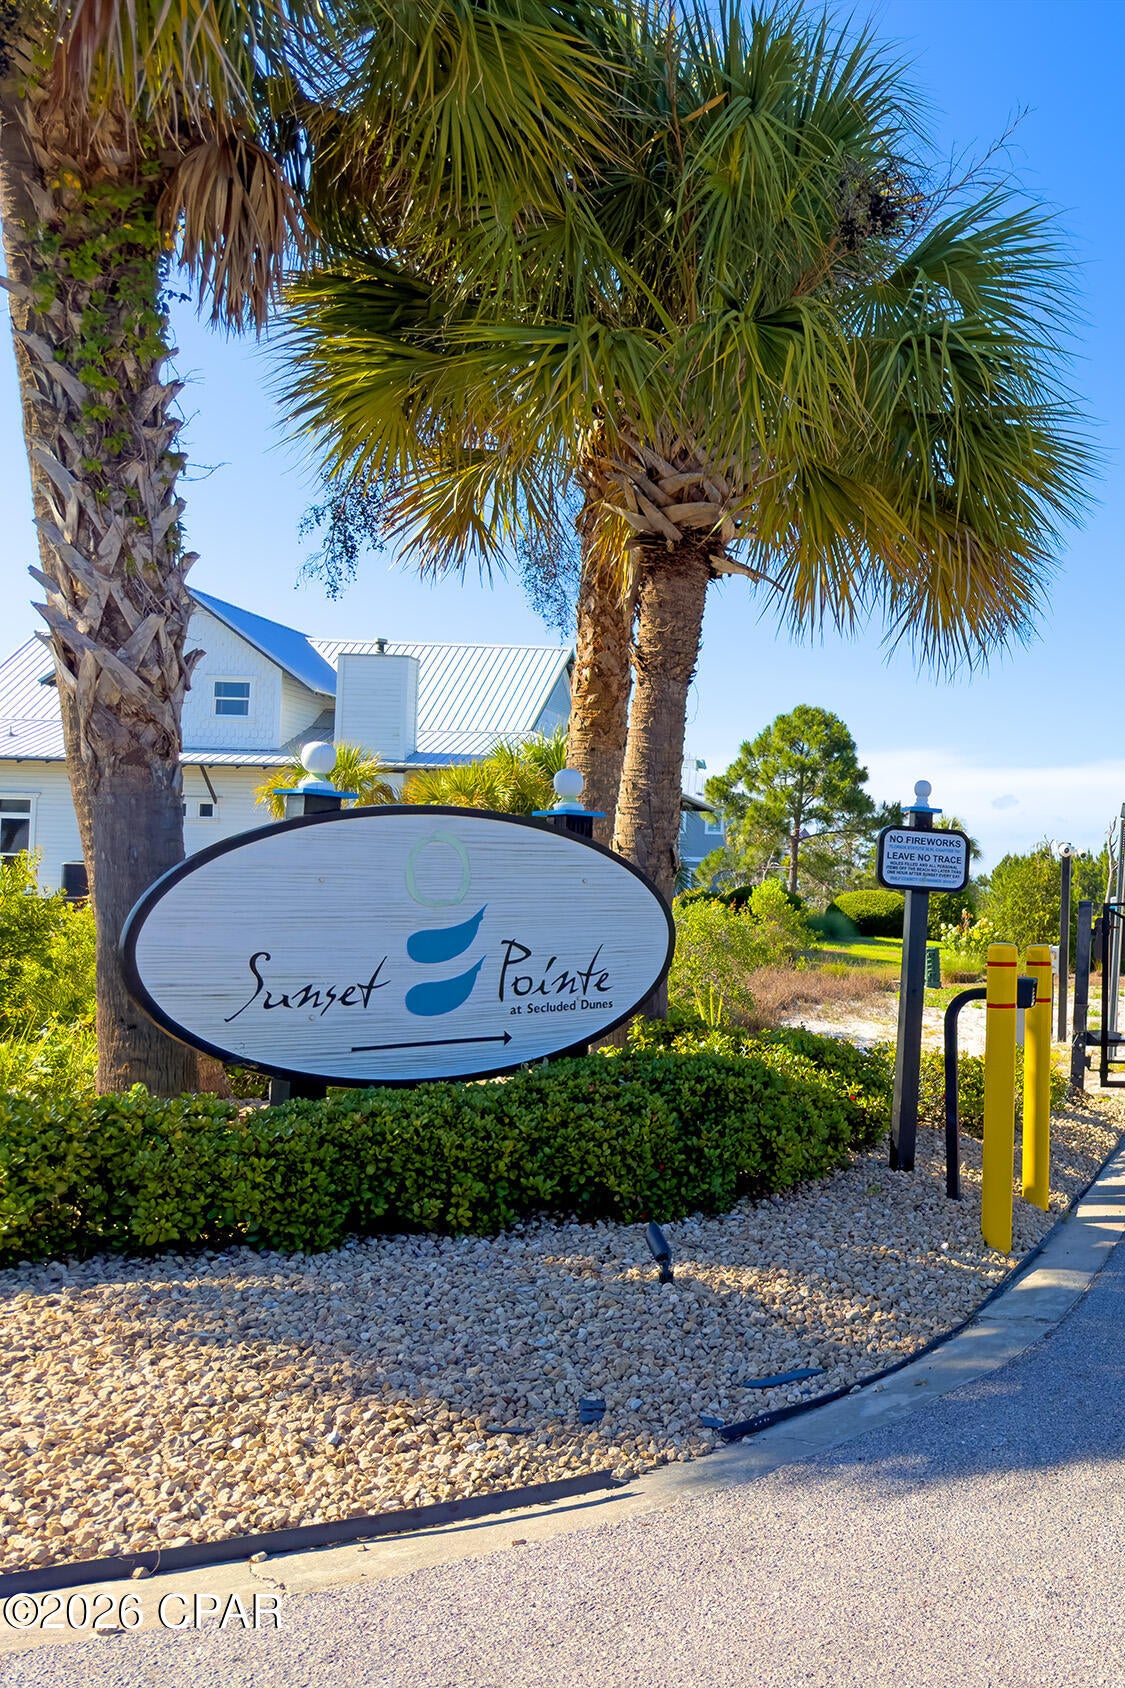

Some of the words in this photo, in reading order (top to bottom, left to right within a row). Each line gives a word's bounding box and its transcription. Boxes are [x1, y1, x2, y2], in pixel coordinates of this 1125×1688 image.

[890, 835, 903, 843] NO
[906, 836, 961, 848] FIREWORKS
[887, 852, 915, 861] LEAVE
[933, 855, 962, 864] TRACE
[223, 951, 391, 1023] Sunset
[498, 938, 615, 1003] Pointe
[509, 1004, 522, 1015] at
[527, 1000, 577, 1013] Secluded
[580, 998, 614, 1011] Dunes
